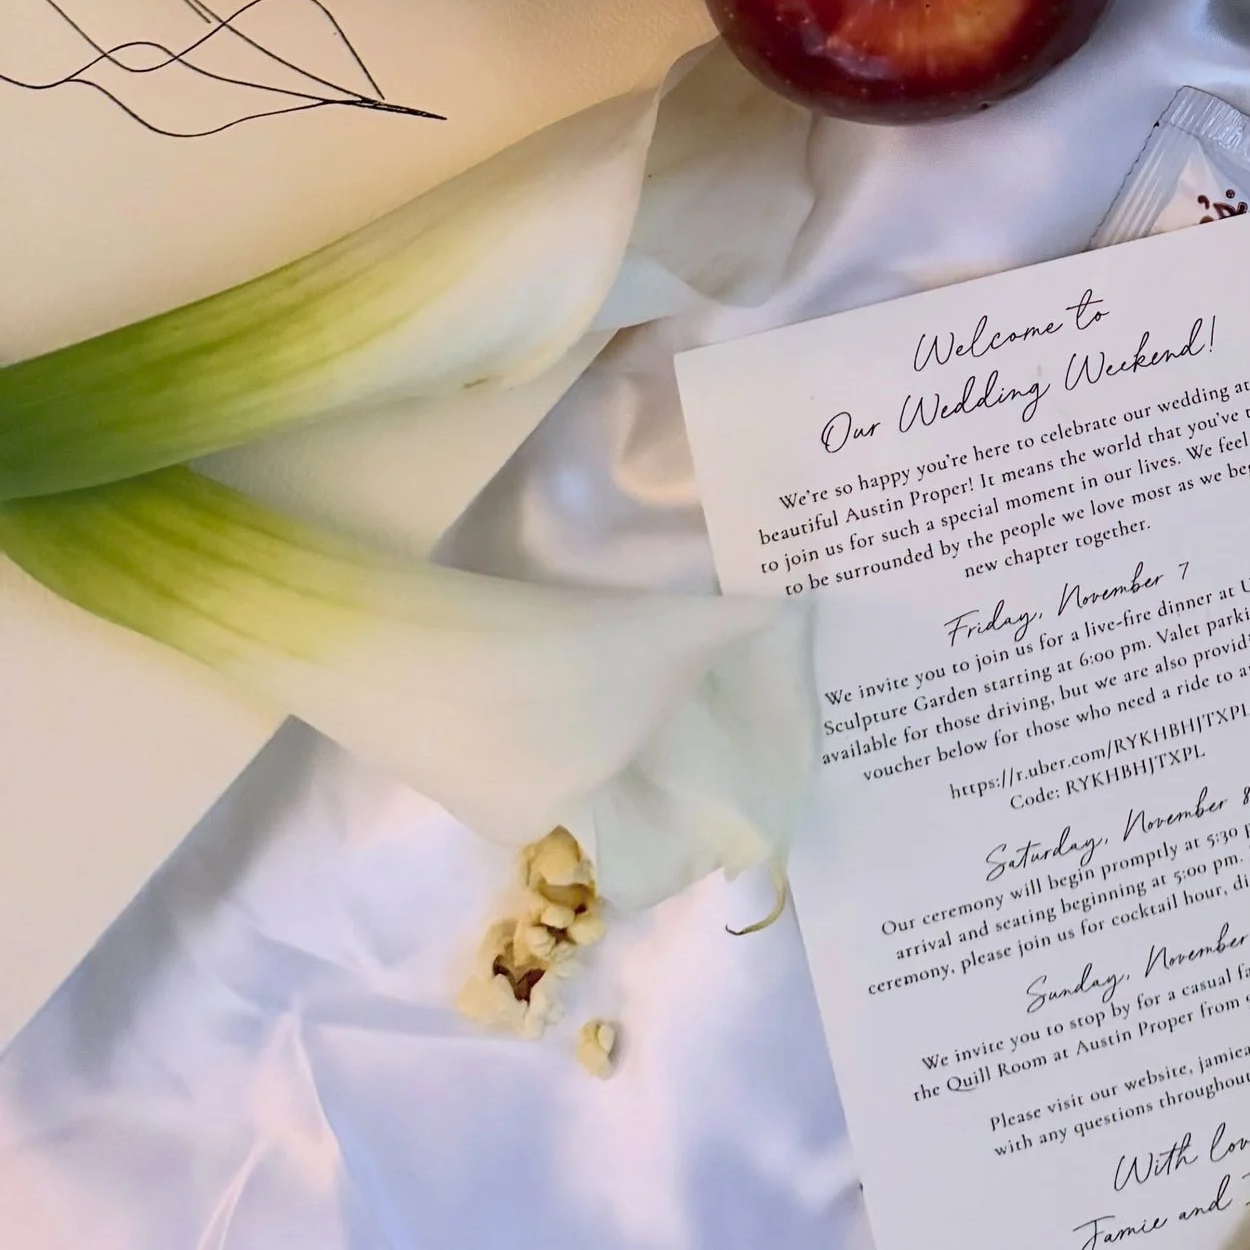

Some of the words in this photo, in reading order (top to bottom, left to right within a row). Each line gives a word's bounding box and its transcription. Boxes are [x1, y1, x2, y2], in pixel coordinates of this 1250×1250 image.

[913, 314, 1064, 373] Welcome
[1065, 288, 1111, 331] to
[820, 411, 882, 454] Our
[898, 369, 1051, 434] Wedding
[1064, 314, 1216, 392] Weekend!
[758, 509, 839, 546] beautiful
[845, 497, 904, 524] Austin
[909, 476, 974, 507] Proper!
[979, 473, 996, 489] It
[1001, 460, 1055, 484] means
[1059, 449, 1087, 468] the
[1092, 431, 1142, 458] world
[1147, 425, 1183, 445] that
[1187, 411, 1240, 440] you've
[778, 489, 829, 510] We're
[834, 483, 853, 497] so
[857, 468, 911, 492] happy
[916, 453, 968, 483] you're
[972, 443, 1011, 462] here
[1016, 437, 1035, 451] to
[1040, 415, 1118, 444] celebrate
[1123, 406, 1152, 423] our
[1156, 386, 1231, 413] wedding
[1234, 381, 1250, 394] at
[964, 559, 998, 579] new
[1004, 540, 1069, 567] chapter
[1075, 519, 1151, 549] together.
[943, 598, 1043, 647] Friday,
[1057, 560, 1165, 617] November
[1178, 561, 1190, 581] 7
[1009, 786, 1060, 810] Code:
[1065, 744, 1206, 796] RYKHBHJTXPL
[985, 825, 1109, 882] Saturday,
[1122, 785, 1228, 843] November
[881, 918, 915, 936] Our
[922, 894, 1004, 926] ceremony
[1009, 877, 1042, 900] will
[1047, 867, 1095, 891] begin
[1100, 841, 1178, 881] promptly
[1184, 838, 1200, 852] at
[1206, 827, 1239, 849] 5:30
[895, 929, 952, 960] arrival
[958, 919, 990, 943] and
[995, 906, 1057, 933] seating
[1060, 880, 1148, 915] beginning
[1151, 874, 1167, 888] at
[1173, 863, 1207, 886] 5:00
[1212, 854, 1244, 876] pm.
[868, 963, 956, 995] ceremony,
[960, 946, 1012, 975] please
[1017, 934, 1051, 958] join
[1057, 928, 1076, 942] us
[1080, 918, 1105, 936] for
[1111, 893, 1178, 927] cocktail
[1182, 885, 1228, 906] hour,
[1025, 962, 1130, 1014] Sunday,
[1144, 921, 1249, 979] November
[990, 1108, 1041, 1132] Please
[1046, 1093, 1085, 1114] visit
[1089, 1085, 1118, 1102] our
[1123, 1064, 1194, 1092] website,
[994, 1133, 1033, 1157] with
[1039, 1127, 1067, 1145] any
[1073, 1102, 1154, 1138] questions
[1113, 1131, 1199, 1192] With
[1072, 1214, 1169, 1250] Jamie
[1178, 1173, 1233, 1221] and
